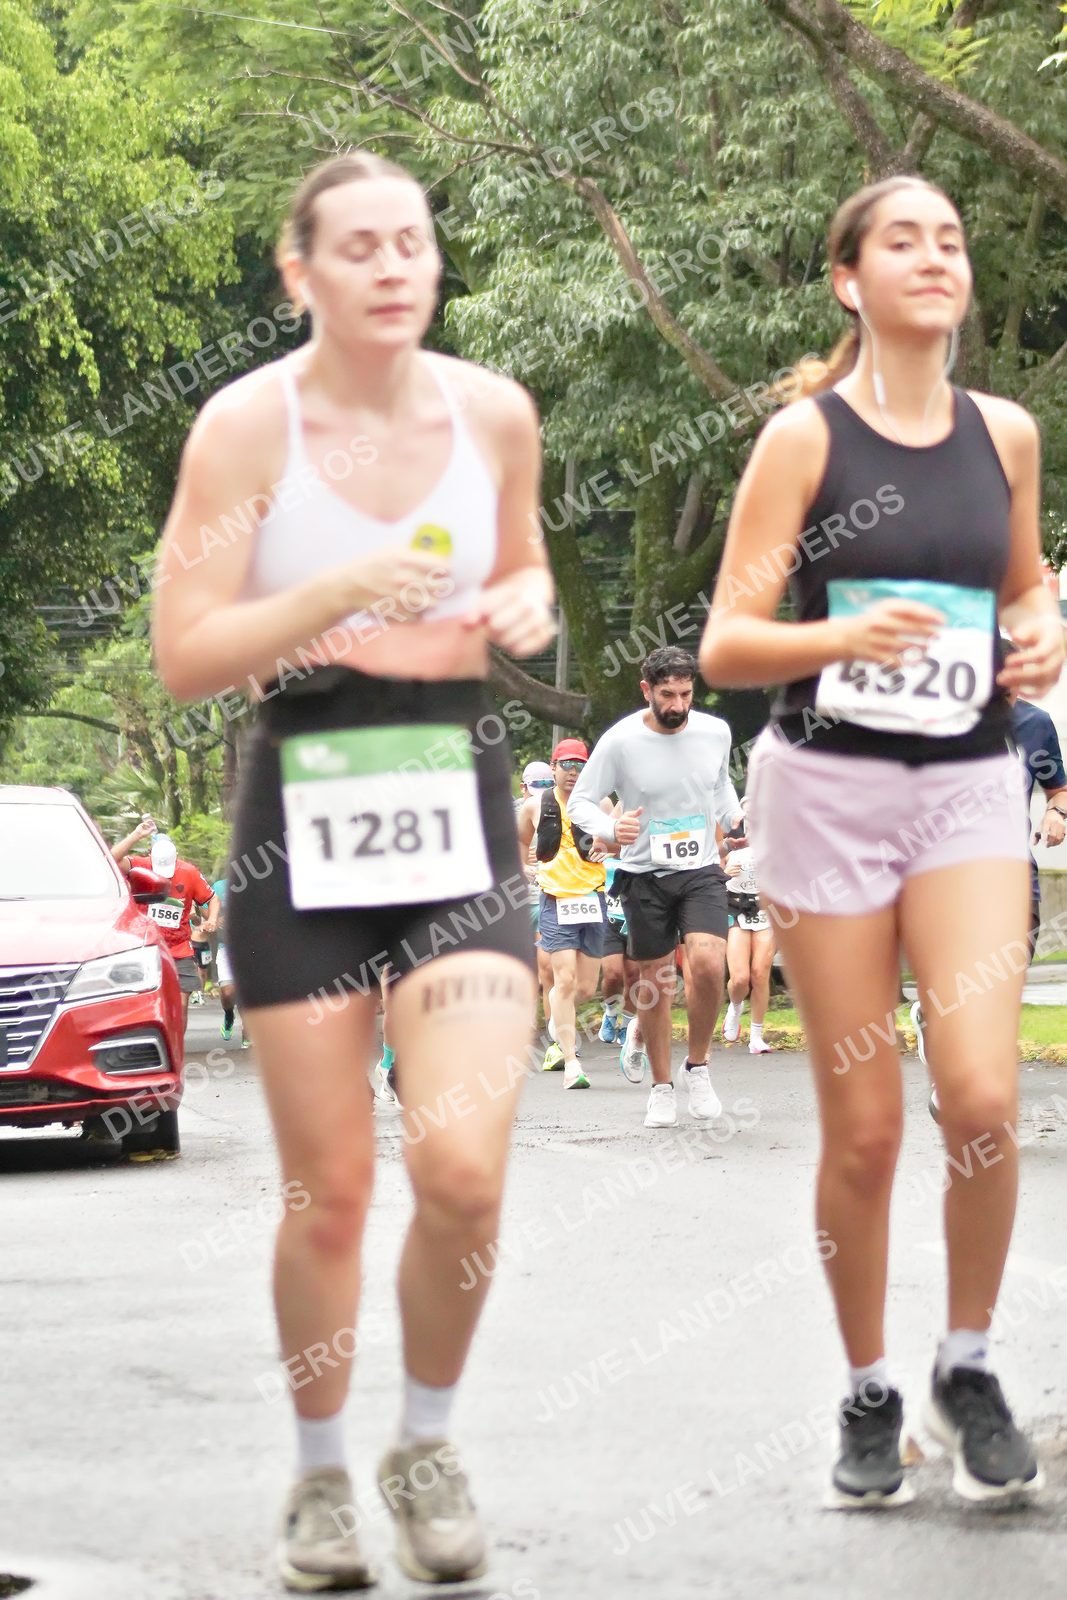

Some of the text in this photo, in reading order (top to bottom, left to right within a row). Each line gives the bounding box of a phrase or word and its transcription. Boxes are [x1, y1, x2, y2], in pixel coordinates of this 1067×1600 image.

[311, 808, 453, 861] 1281
[662, 840, 699, 859] 169
[151, 908, 180, 921] 1586
[560, 903, 598, 916] 3566
